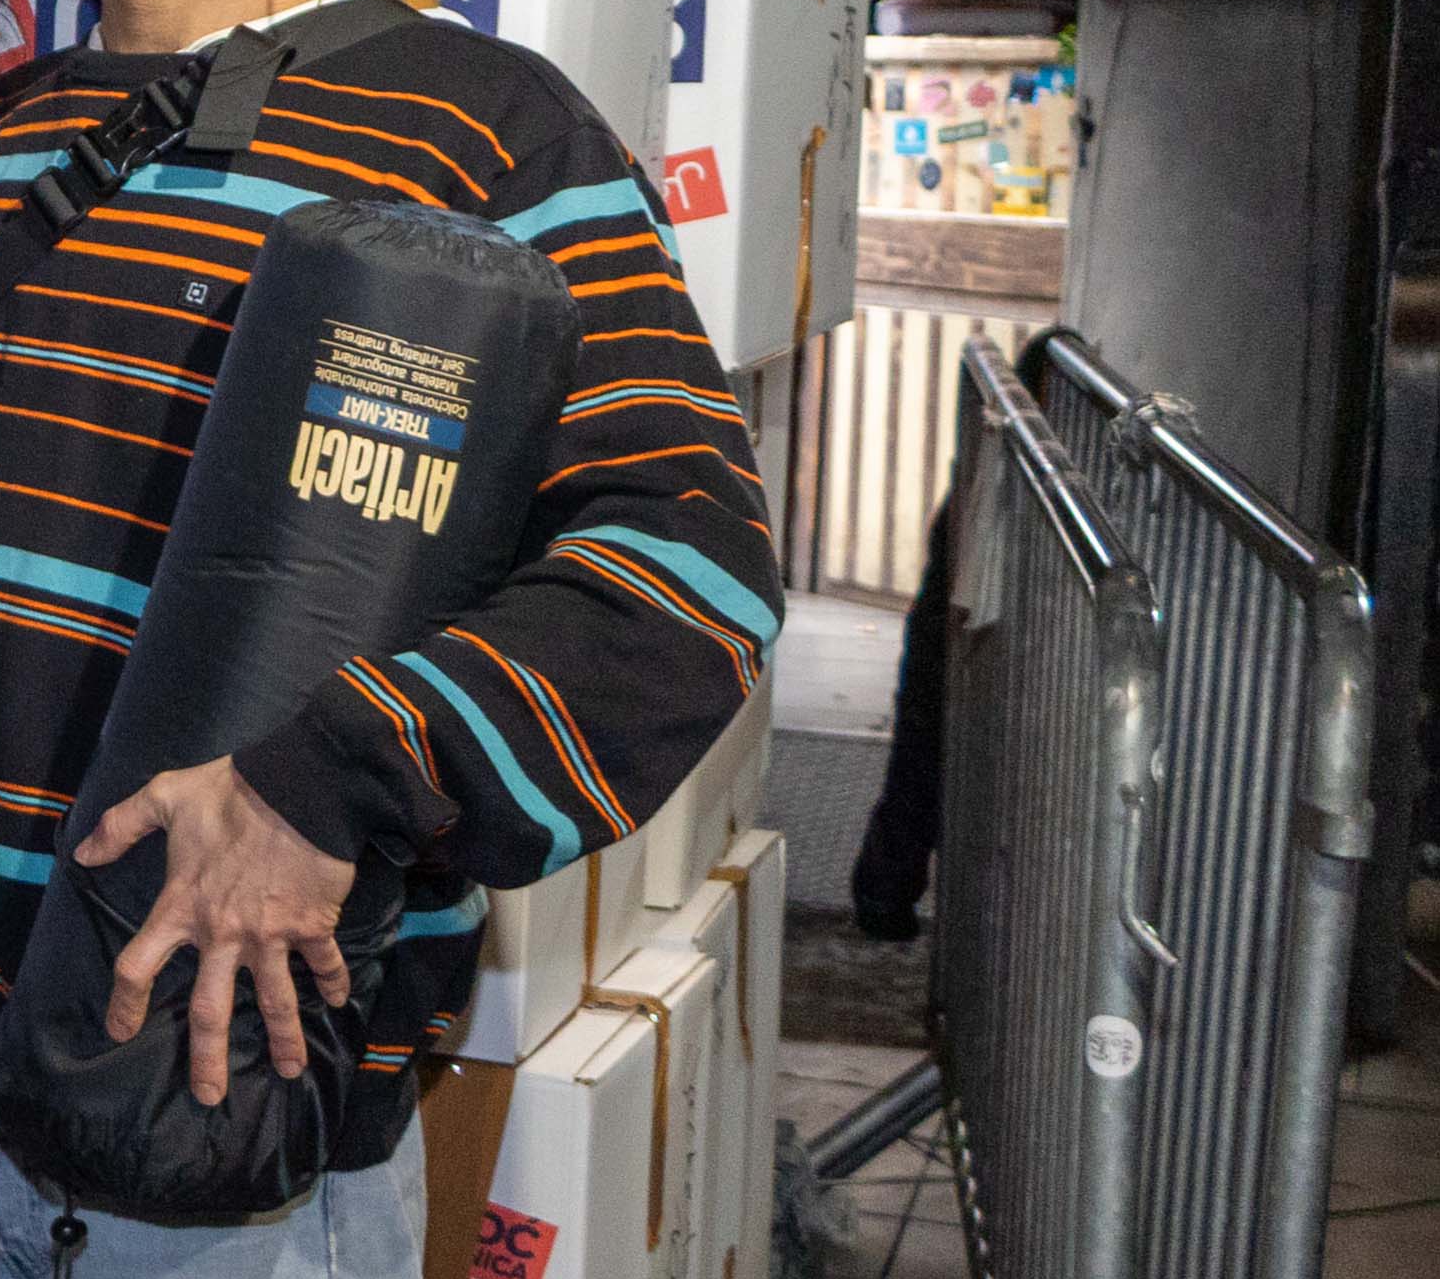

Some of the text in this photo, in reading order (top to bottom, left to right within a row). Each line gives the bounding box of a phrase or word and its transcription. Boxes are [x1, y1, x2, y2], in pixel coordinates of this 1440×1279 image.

[332, 350, 459, 395] Matelas autogonflant
[334, 326, 466, 376] Self-inflating mattress
[315, 365, 468, 419] Colchoneta autohinchable
[339, 393, 431, 441] TREK-MAT
[289, 421, 460, 536] Artiach
